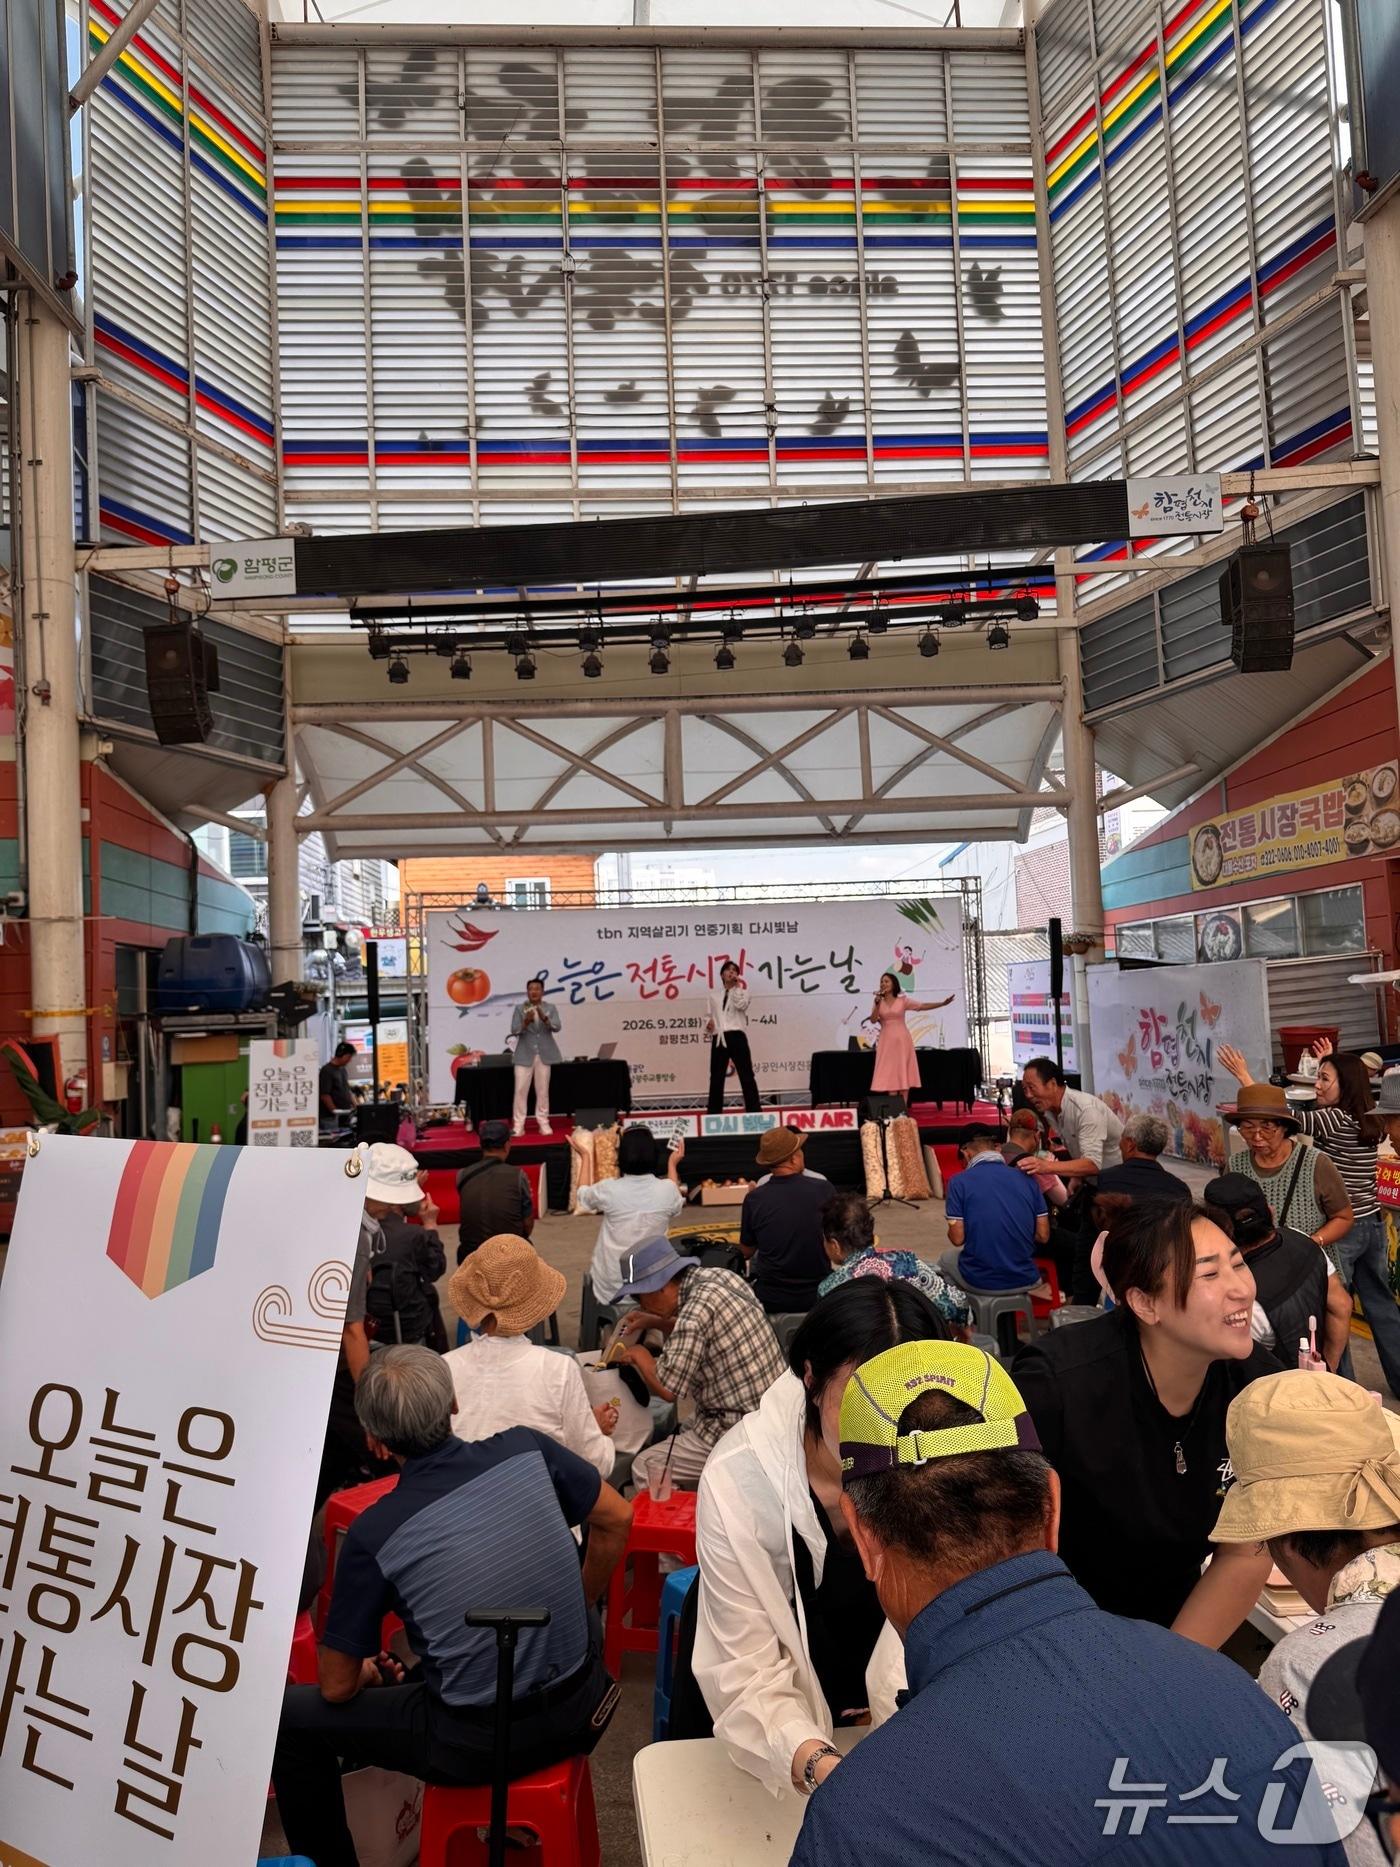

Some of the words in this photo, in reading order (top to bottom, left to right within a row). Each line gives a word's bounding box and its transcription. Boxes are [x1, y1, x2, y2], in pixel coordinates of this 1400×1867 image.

[244, 556, 293, 573] 함평군
[597, 927, 622, 940] tbn
[628, 924, 689, 939] 지역살리기
[694, 922, 743, 937] 연중기획
[749, 920, 799, 935] 다시빛남
[622, 1016, 702, 1031] 2026.9.22(화)
[659, 1034, 699, 1046] 함평천지
[261, 1065, 308, 1082] 오늘은
[255, 1080, 314, 1098] 전통시장
[259, 1097, 290, 1112] 가는
[819, 1111, 854, 1128] AIR
[10, 1382, 236, 1537] 오늘은
[113, 1679, 203, 1841] 날
